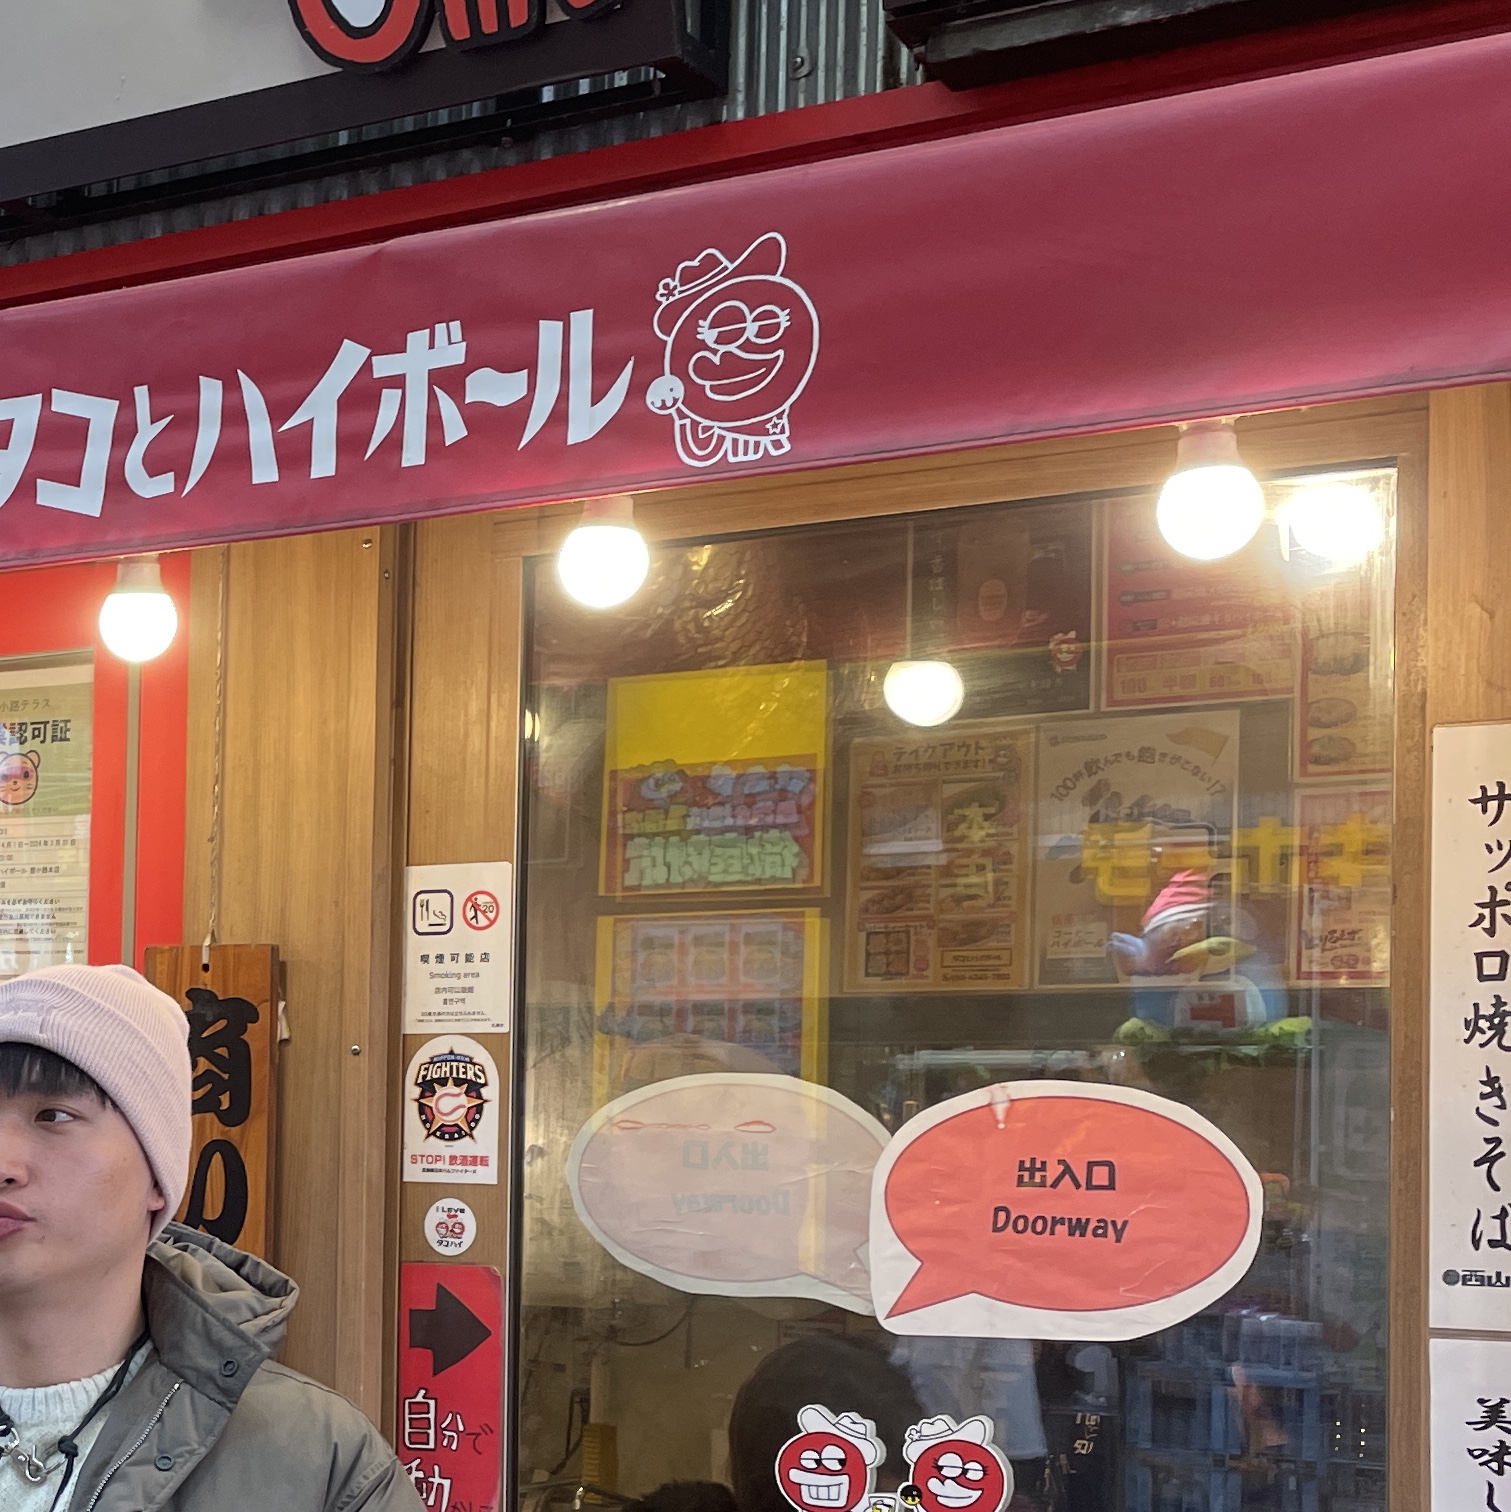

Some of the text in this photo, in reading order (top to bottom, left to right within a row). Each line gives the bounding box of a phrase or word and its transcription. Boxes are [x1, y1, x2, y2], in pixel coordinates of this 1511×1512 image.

[429, 971, 480, 980] Smoking area
[417, 1062, 486, 1084] FIGHTERS
[1016, 1157, 1116, 1191] 出入口
[992, 1205, 1129, 1244] Doorway
[402, 1387, 494, 1455] 自分で
